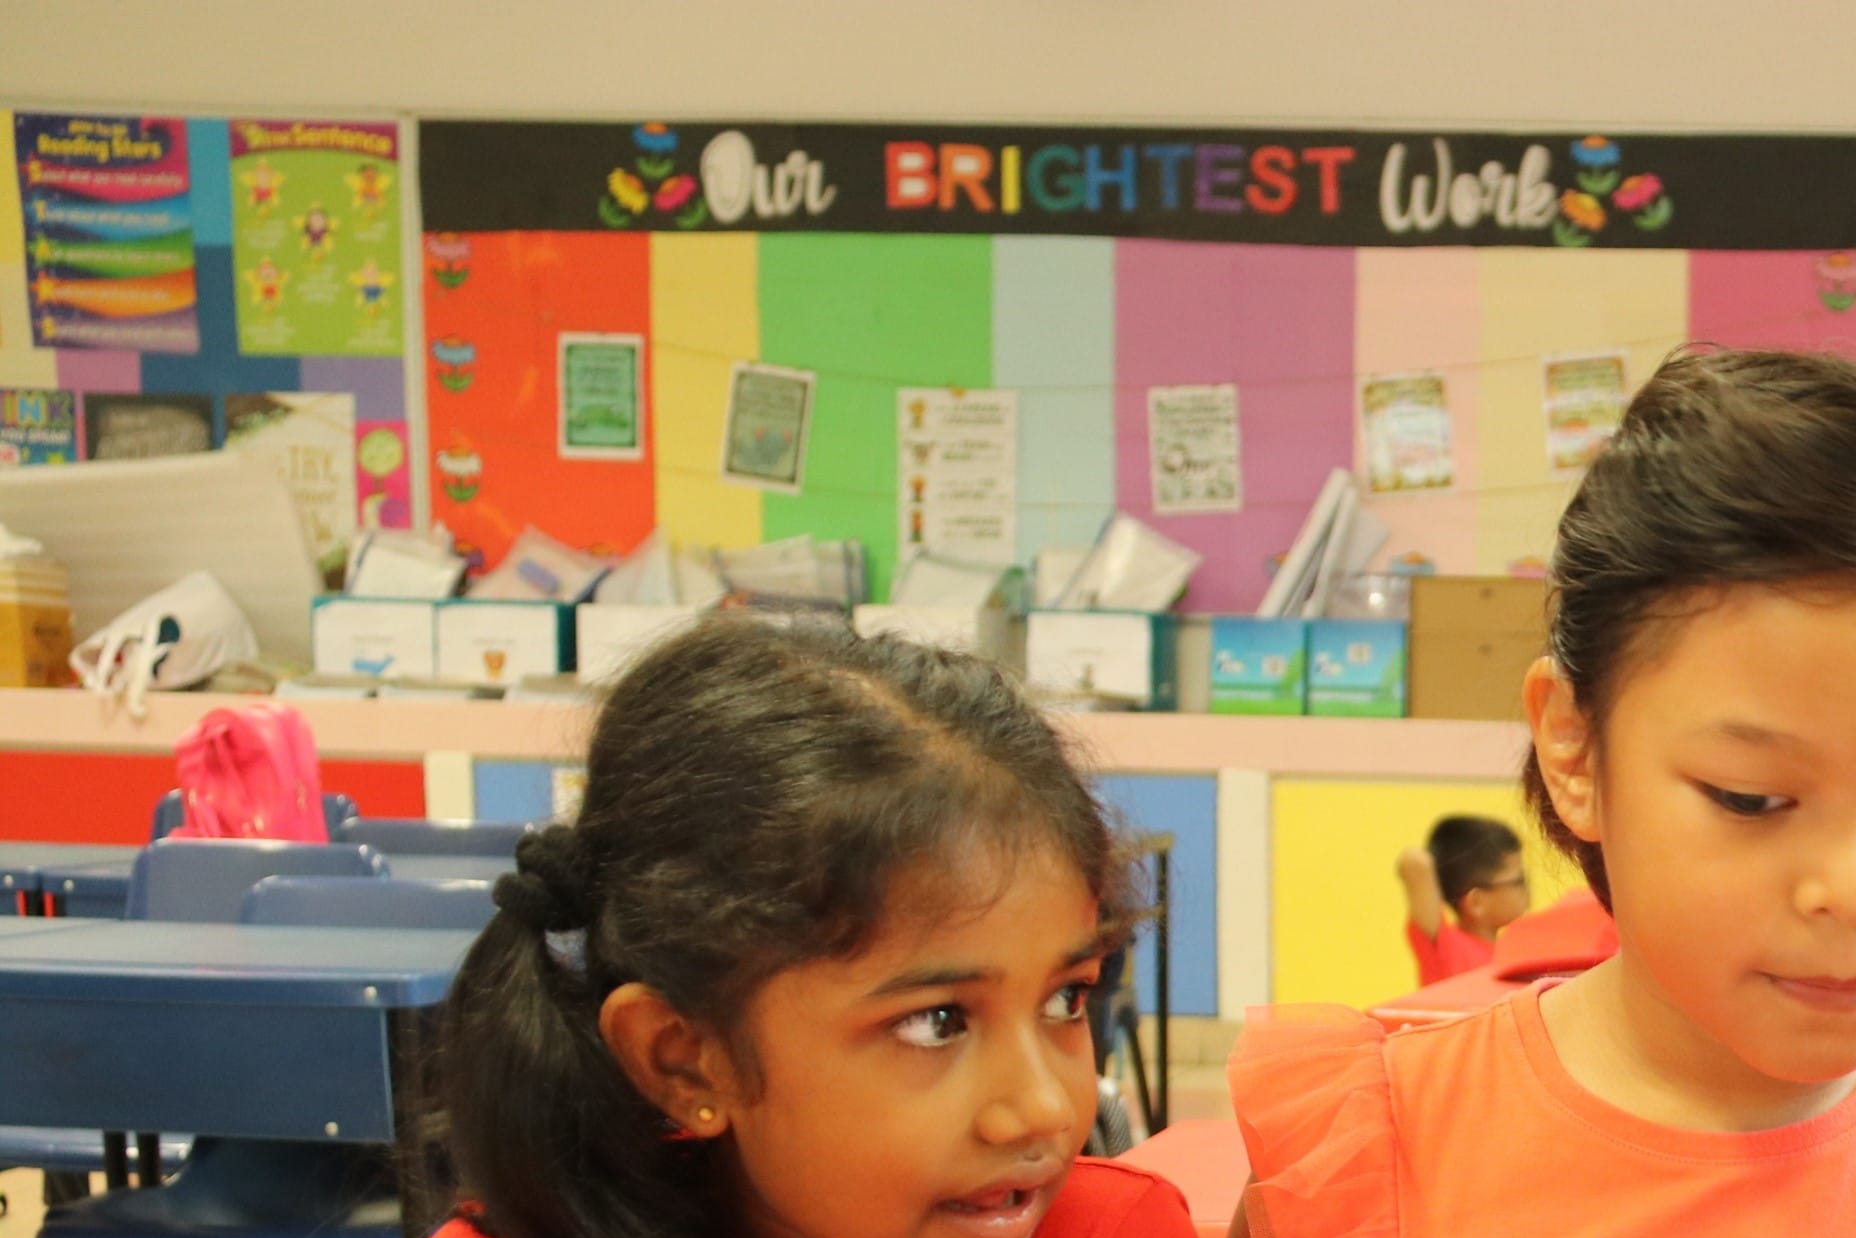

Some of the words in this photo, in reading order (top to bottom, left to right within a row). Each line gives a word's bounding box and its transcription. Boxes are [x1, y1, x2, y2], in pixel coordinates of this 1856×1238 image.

[700, 130, 838, 223] Our
[884, 141, 1355, 215] BRIGHTEST
[1380, 137, 1557, 233] Work
